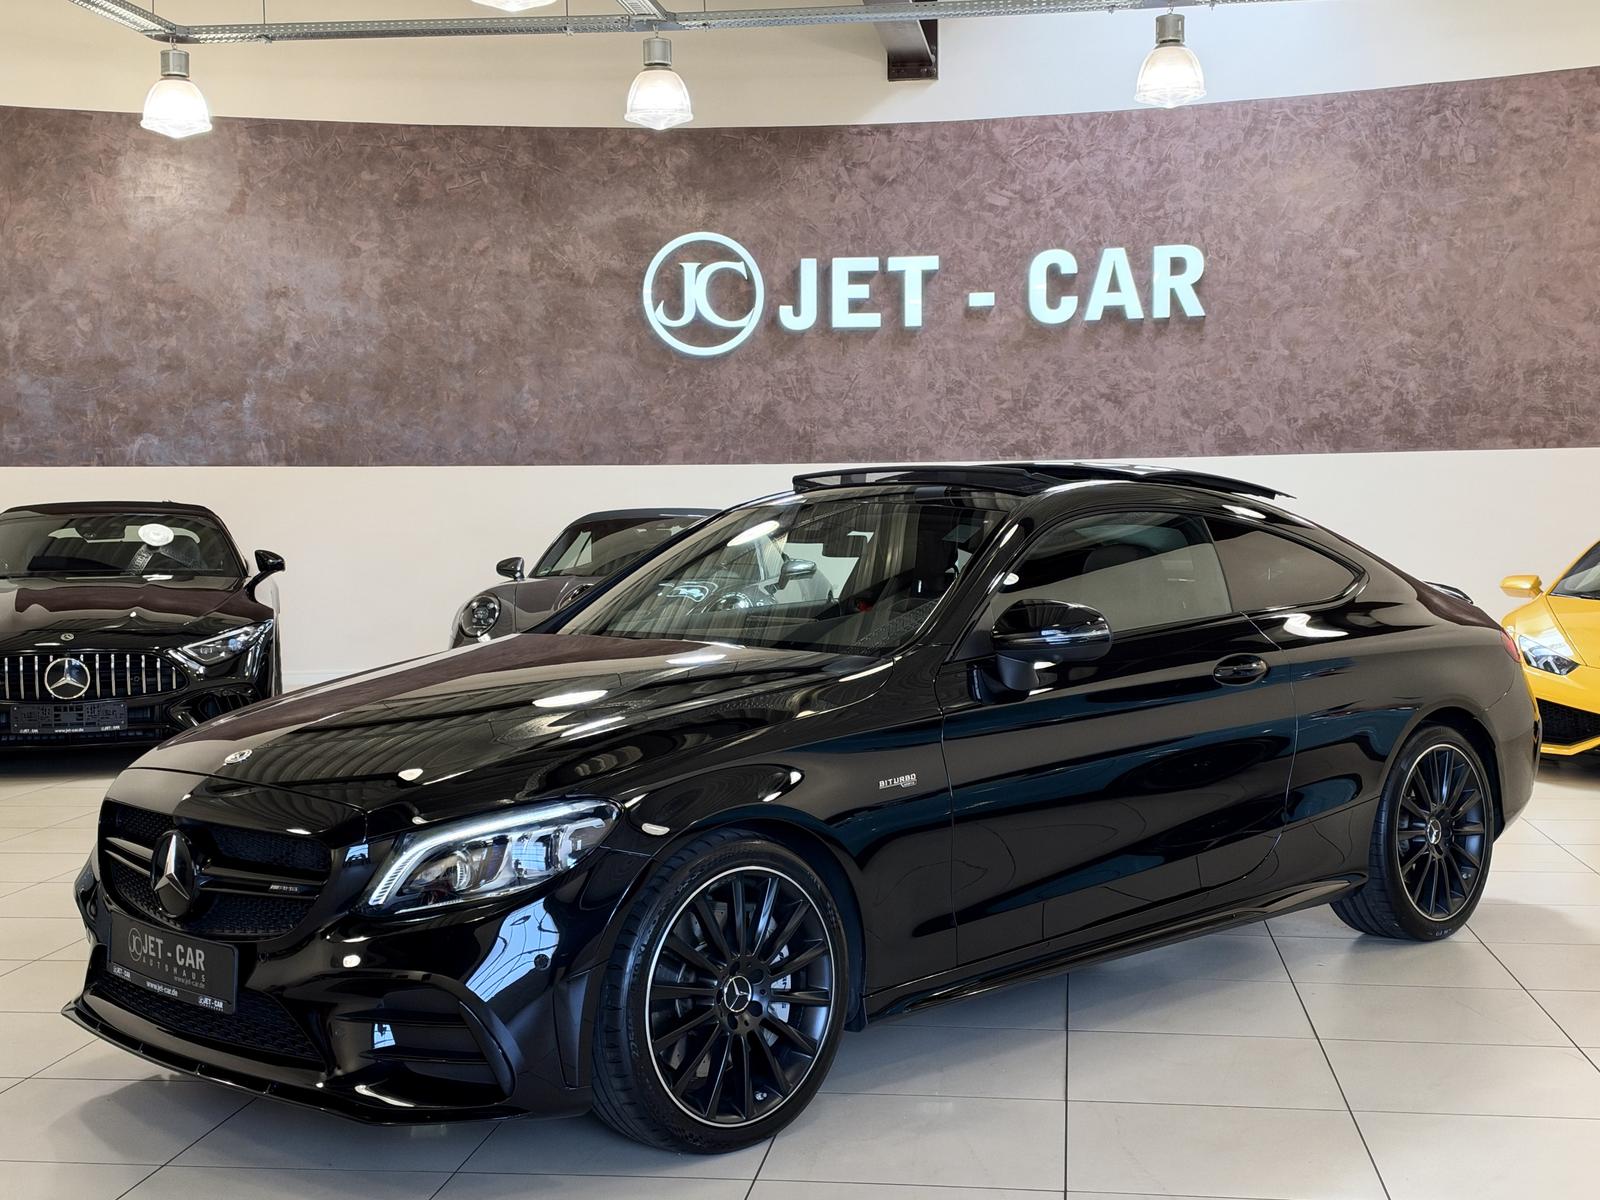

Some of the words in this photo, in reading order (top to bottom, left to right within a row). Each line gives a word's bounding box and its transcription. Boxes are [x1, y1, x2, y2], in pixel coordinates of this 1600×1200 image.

[779, 254, 940, 332] JET
[968, 291, 996, 308] -
[1028, 244, 1206, 325] CAR
[879, 773, 916, 786] BITURBO
[142, 934, 163, 959] JET
[176, 944, 206, 971] CAR
